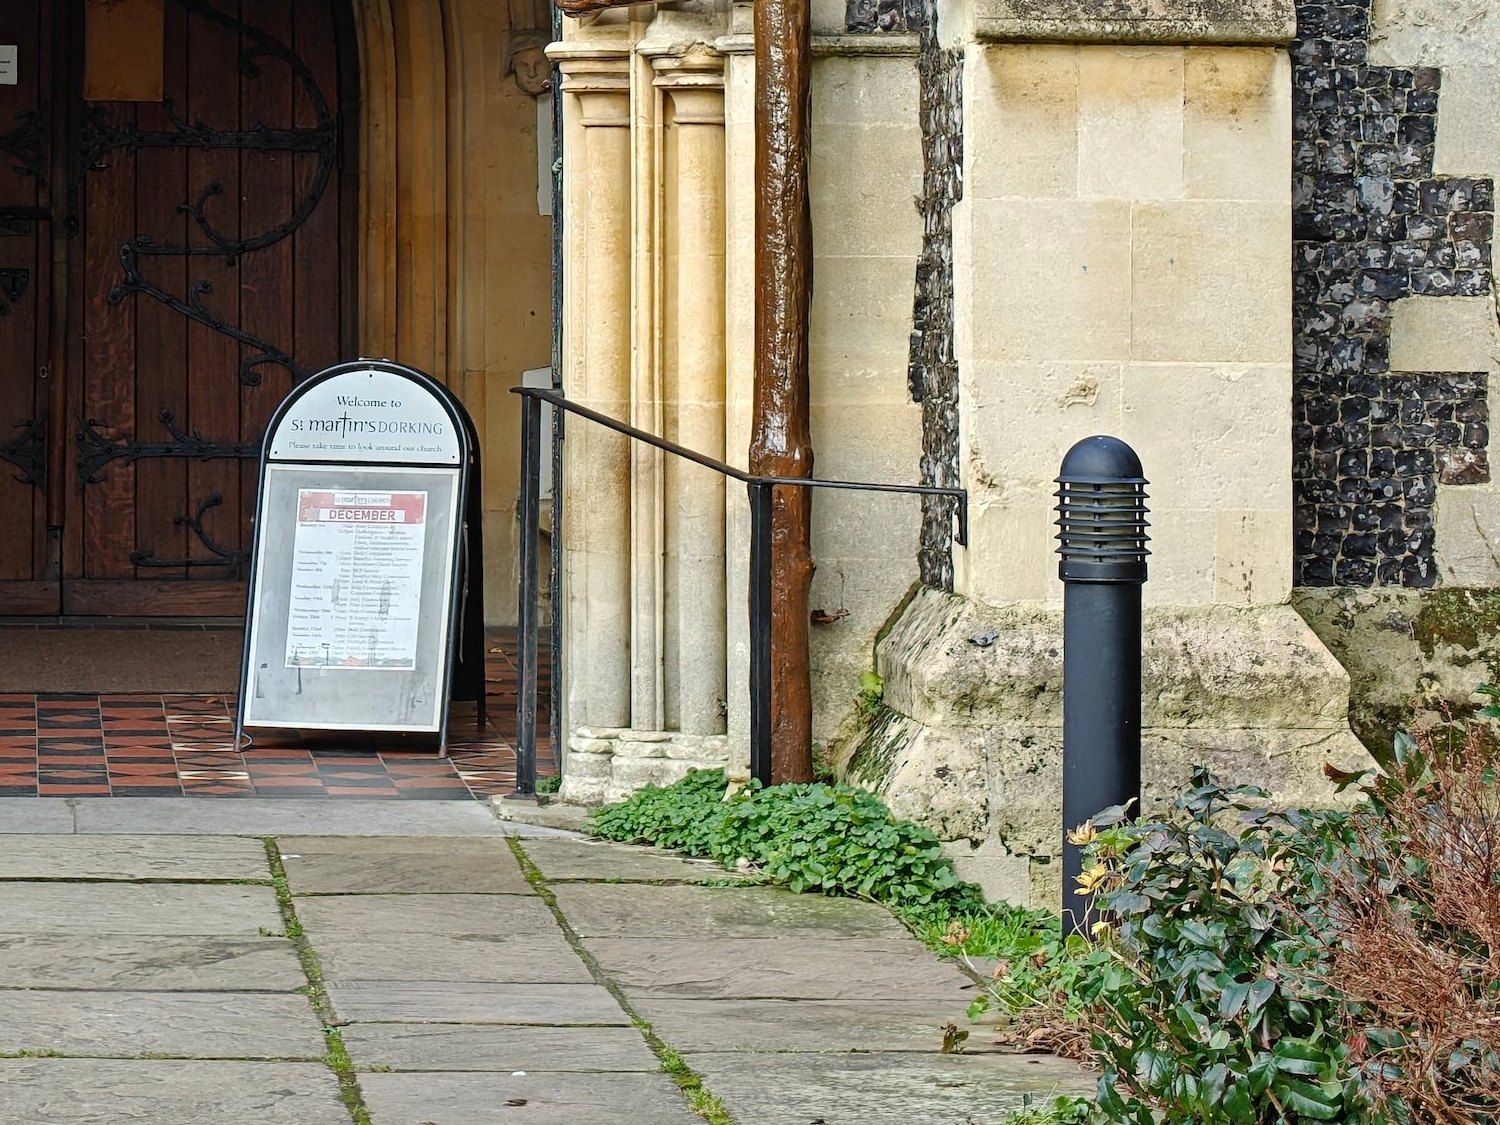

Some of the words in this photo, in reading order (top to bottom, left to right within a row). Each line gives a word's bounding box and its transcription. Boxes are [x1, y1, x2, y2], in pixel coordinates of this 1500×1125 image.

[337, 396, 387, 407] Welcome
[378, 421, 443, 435] DORKING
[288, 441, 311, 449] Please
[312, 442, 328, 450] take
[358, 442, 373, 452] look
[329, 509, 396, 520] DECEMBER
